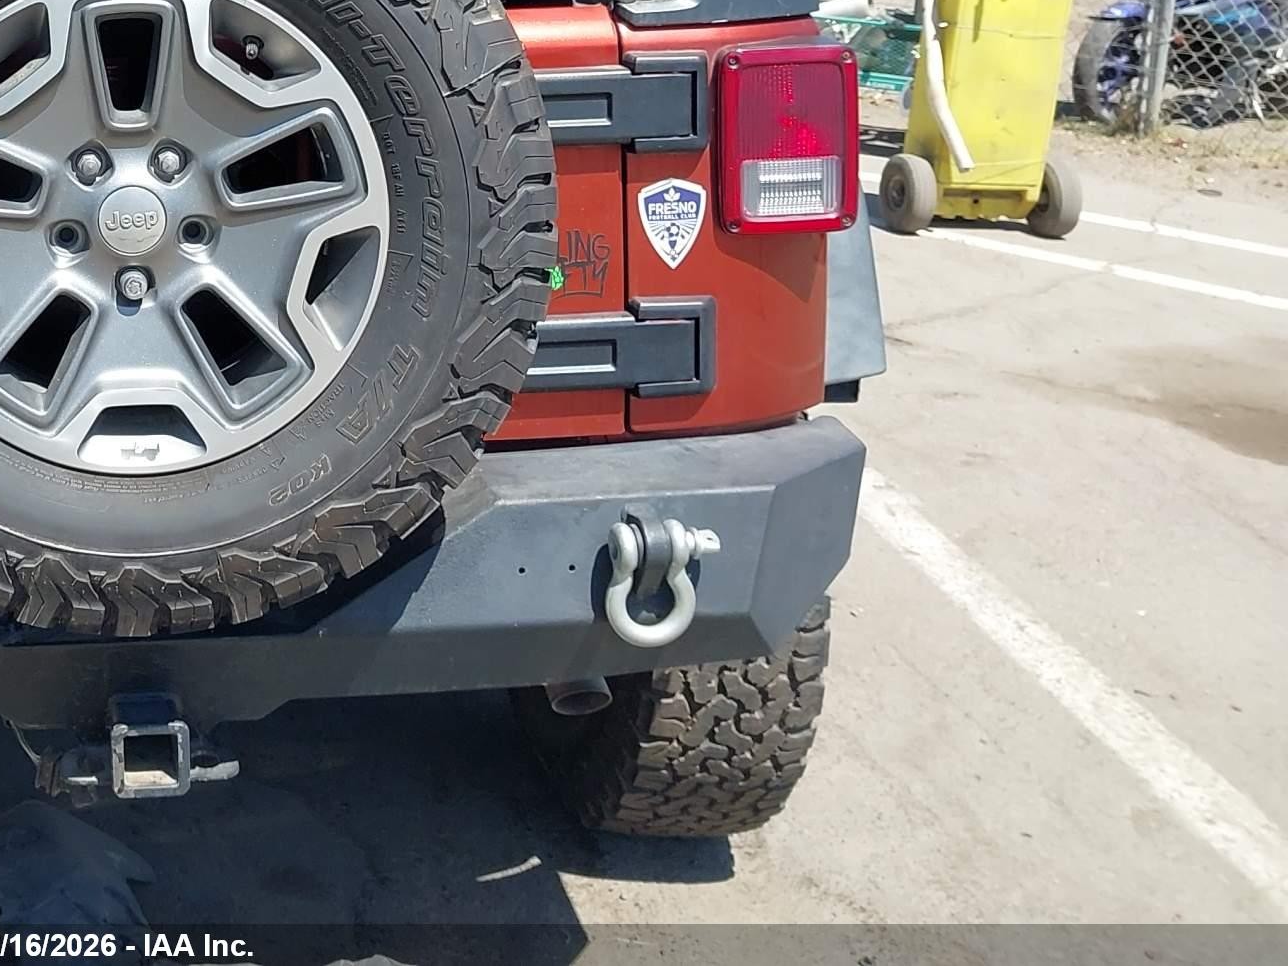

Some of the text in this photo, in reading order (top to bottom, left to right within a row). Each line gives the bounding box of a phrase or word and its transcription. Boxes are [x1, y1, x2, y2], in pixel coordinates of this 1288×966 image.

[647, 201, 697, 215] FRESNO
[104, 210, 159, 232] Jeep
[268, 452, 333, 507] KO2
